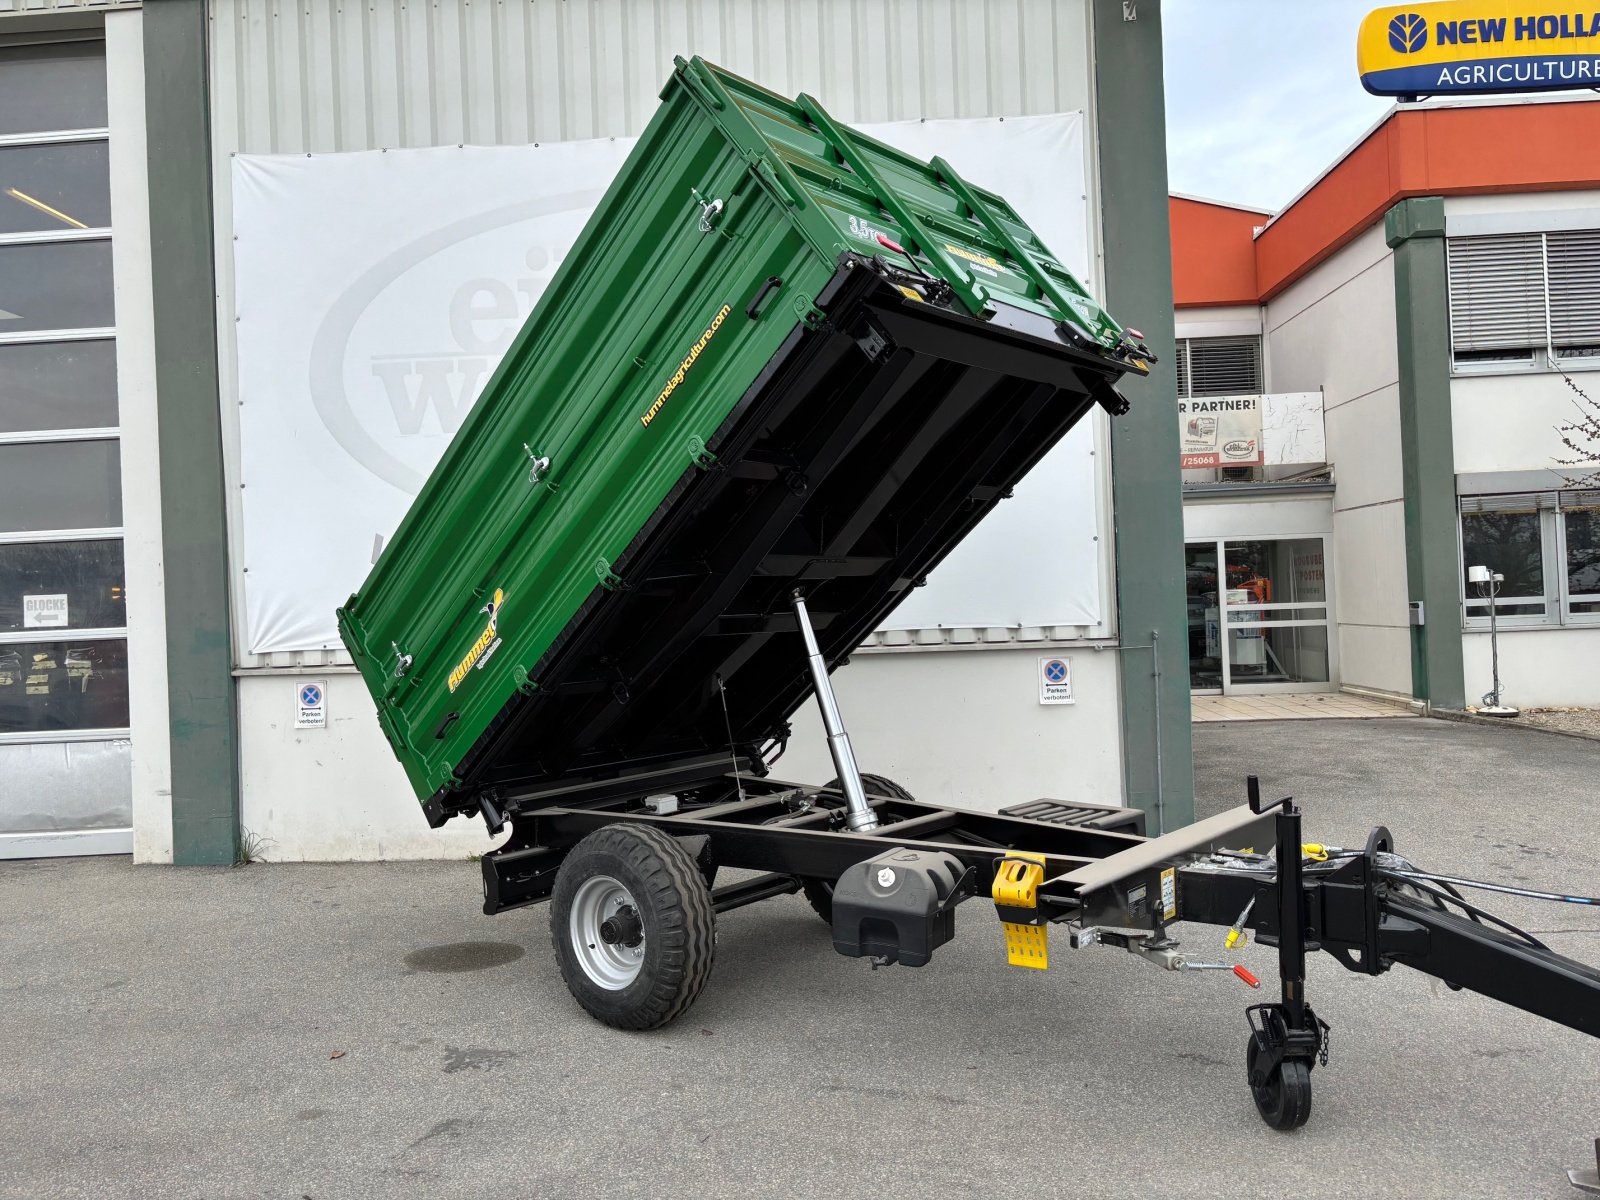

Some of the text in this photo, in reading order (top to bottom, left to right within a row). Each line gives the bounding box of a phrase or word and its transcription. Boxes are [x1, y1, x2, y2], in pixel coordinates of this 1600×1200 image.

[1437, 18, 1506, 45] NEW
[1437, 60, 1600, 85] AGRICULTURE
[641, 304, 731, 428] hummelagriculture.com
[1192, 399, 1256, 412] PARTNER!
[1183, 456, 1214, 465] /25068
[26, 598, 66, 612] GLOCKE
[448, 622, 496, 693] Hummel
